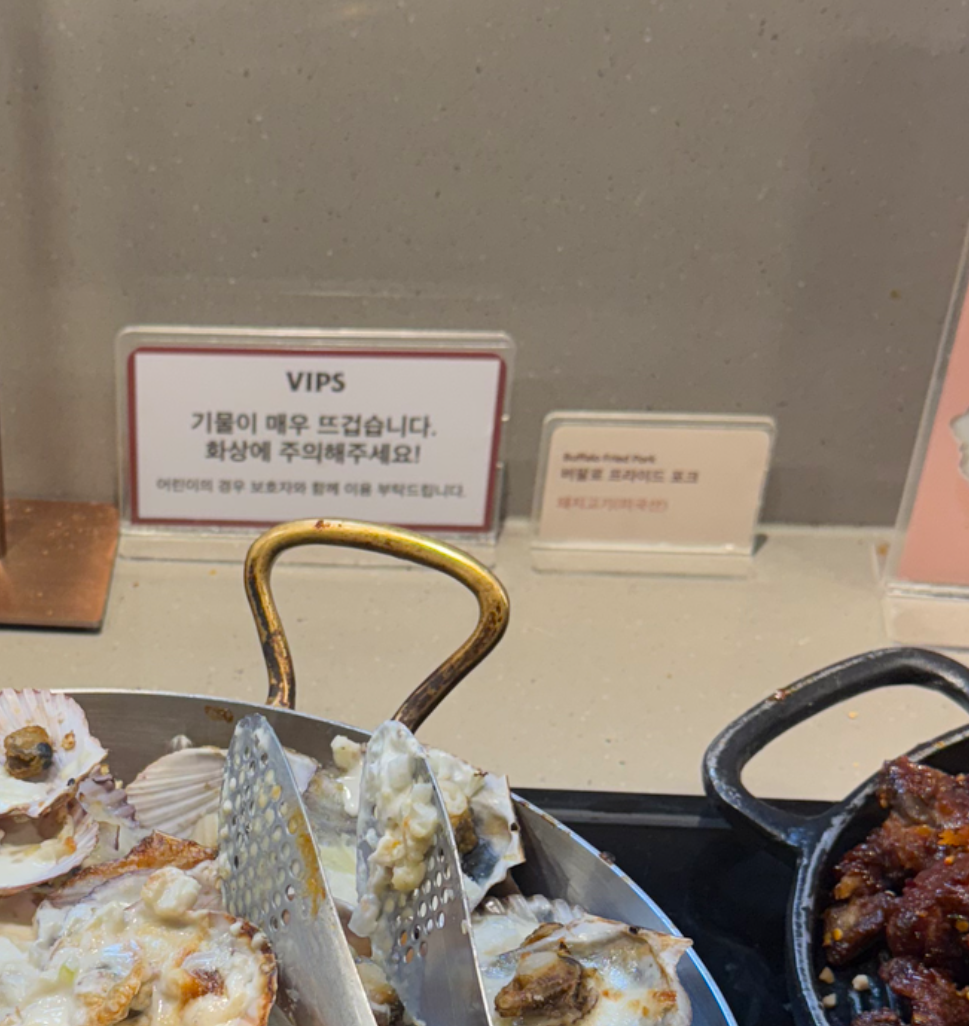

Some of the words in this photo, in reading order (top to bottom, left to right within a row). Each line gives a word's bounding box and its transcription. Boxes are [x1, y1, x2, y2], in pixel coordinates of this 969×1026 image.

[286, 371, 346, 393] VIPS
[190, 410, 257, 436] 기물이
[265, 412, 310, 436] 매우
[317, 413, 437, 439] 뜨겁습니다.
[204, 439, 271, 464] 화상에
[278, 440, 421, 466] 주의해주세요!
[156, 477, 214, 494] 어린이의
[218, 479, 245, 495] 경우
[250, 480, 307, 495] 보호자와
[311, 481, 339, 497] 함께
[343, 482, 372, 498] 이용
